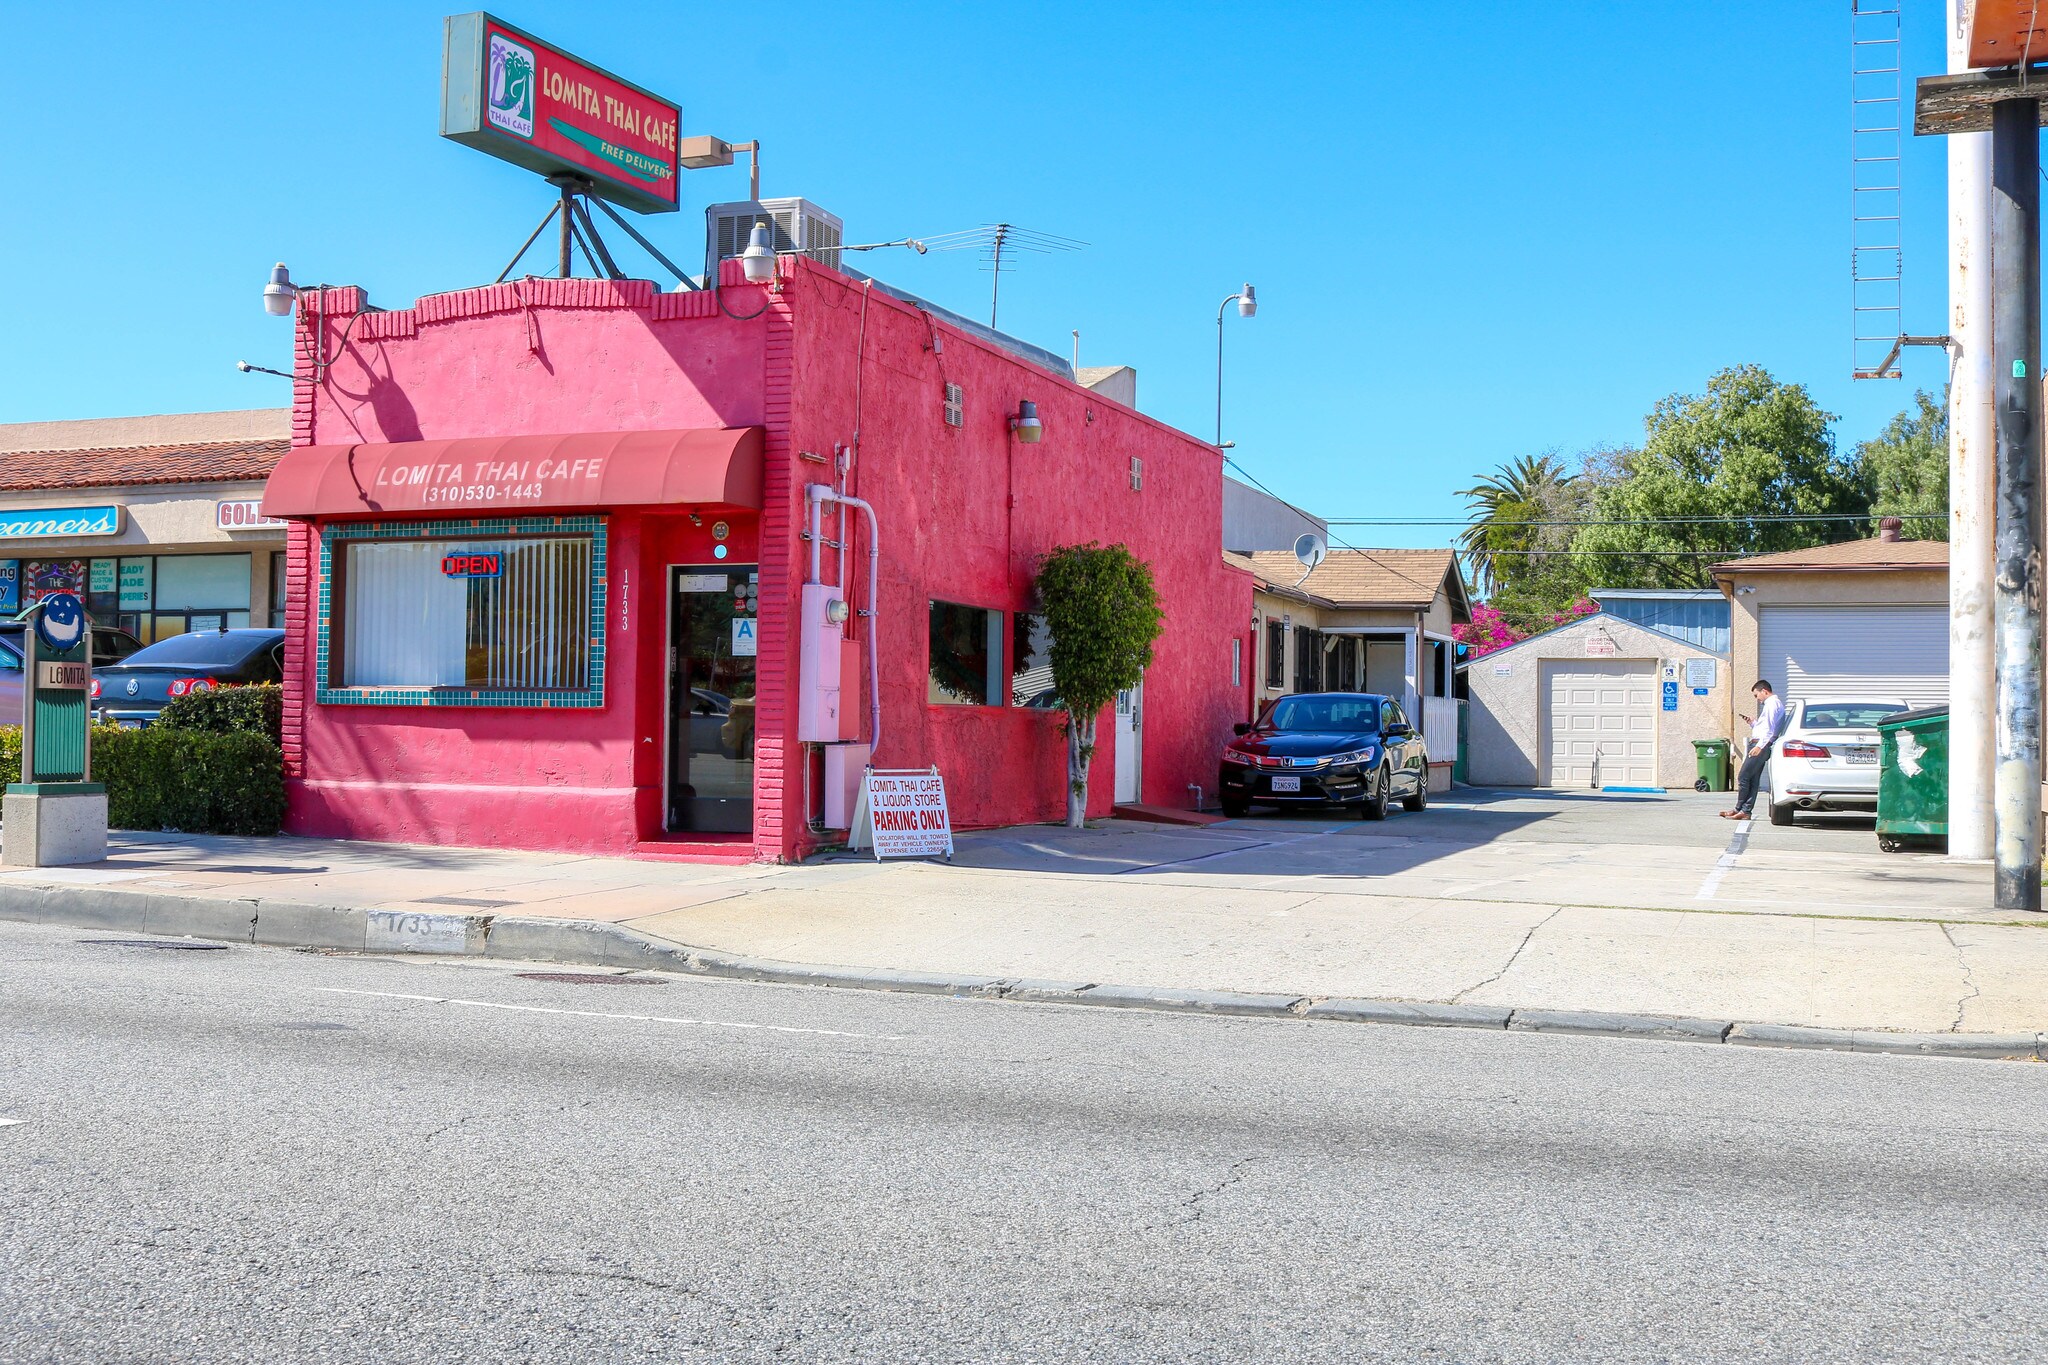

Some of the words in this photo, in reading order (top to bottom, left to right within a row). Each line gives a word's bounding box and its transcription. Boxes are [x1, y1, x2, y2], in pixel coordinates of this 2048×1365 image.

[490, 110, 510, 126] THAI
[543, 66, 601, 120] LOMITA
[604, 95, 640, 137] THAI
[643, 119, 676, 153] CAFÉ
[601, 141, 624, 161] FREE
[625, 153, 674, 181] DELIVERY
[376, 463, 463, 486] LOMITA
[474, 461, 529, 482] THAI
[536, 458, 603, 480] CAFE
[422, 483, 543, 503] (310)530-1443
[441, 556, 498, 574] OPEN
[49, 577, 64, 588] THE
[738, 621, 752, 638] A
[50, 666, 86, 684] LOMITA
[869, 780, 898, 792] LOMITA
[900, 780, 918, 792] THAI
[874, 795, 880, 806] &
[882, 795, 912, 806] LIQUOR
[915, 794, 941, 806] STORE
[873, 810, 918, 831] PARKING
[920, 809, 945, 830] ONLY
[388, 913, 432, 936] 1733
